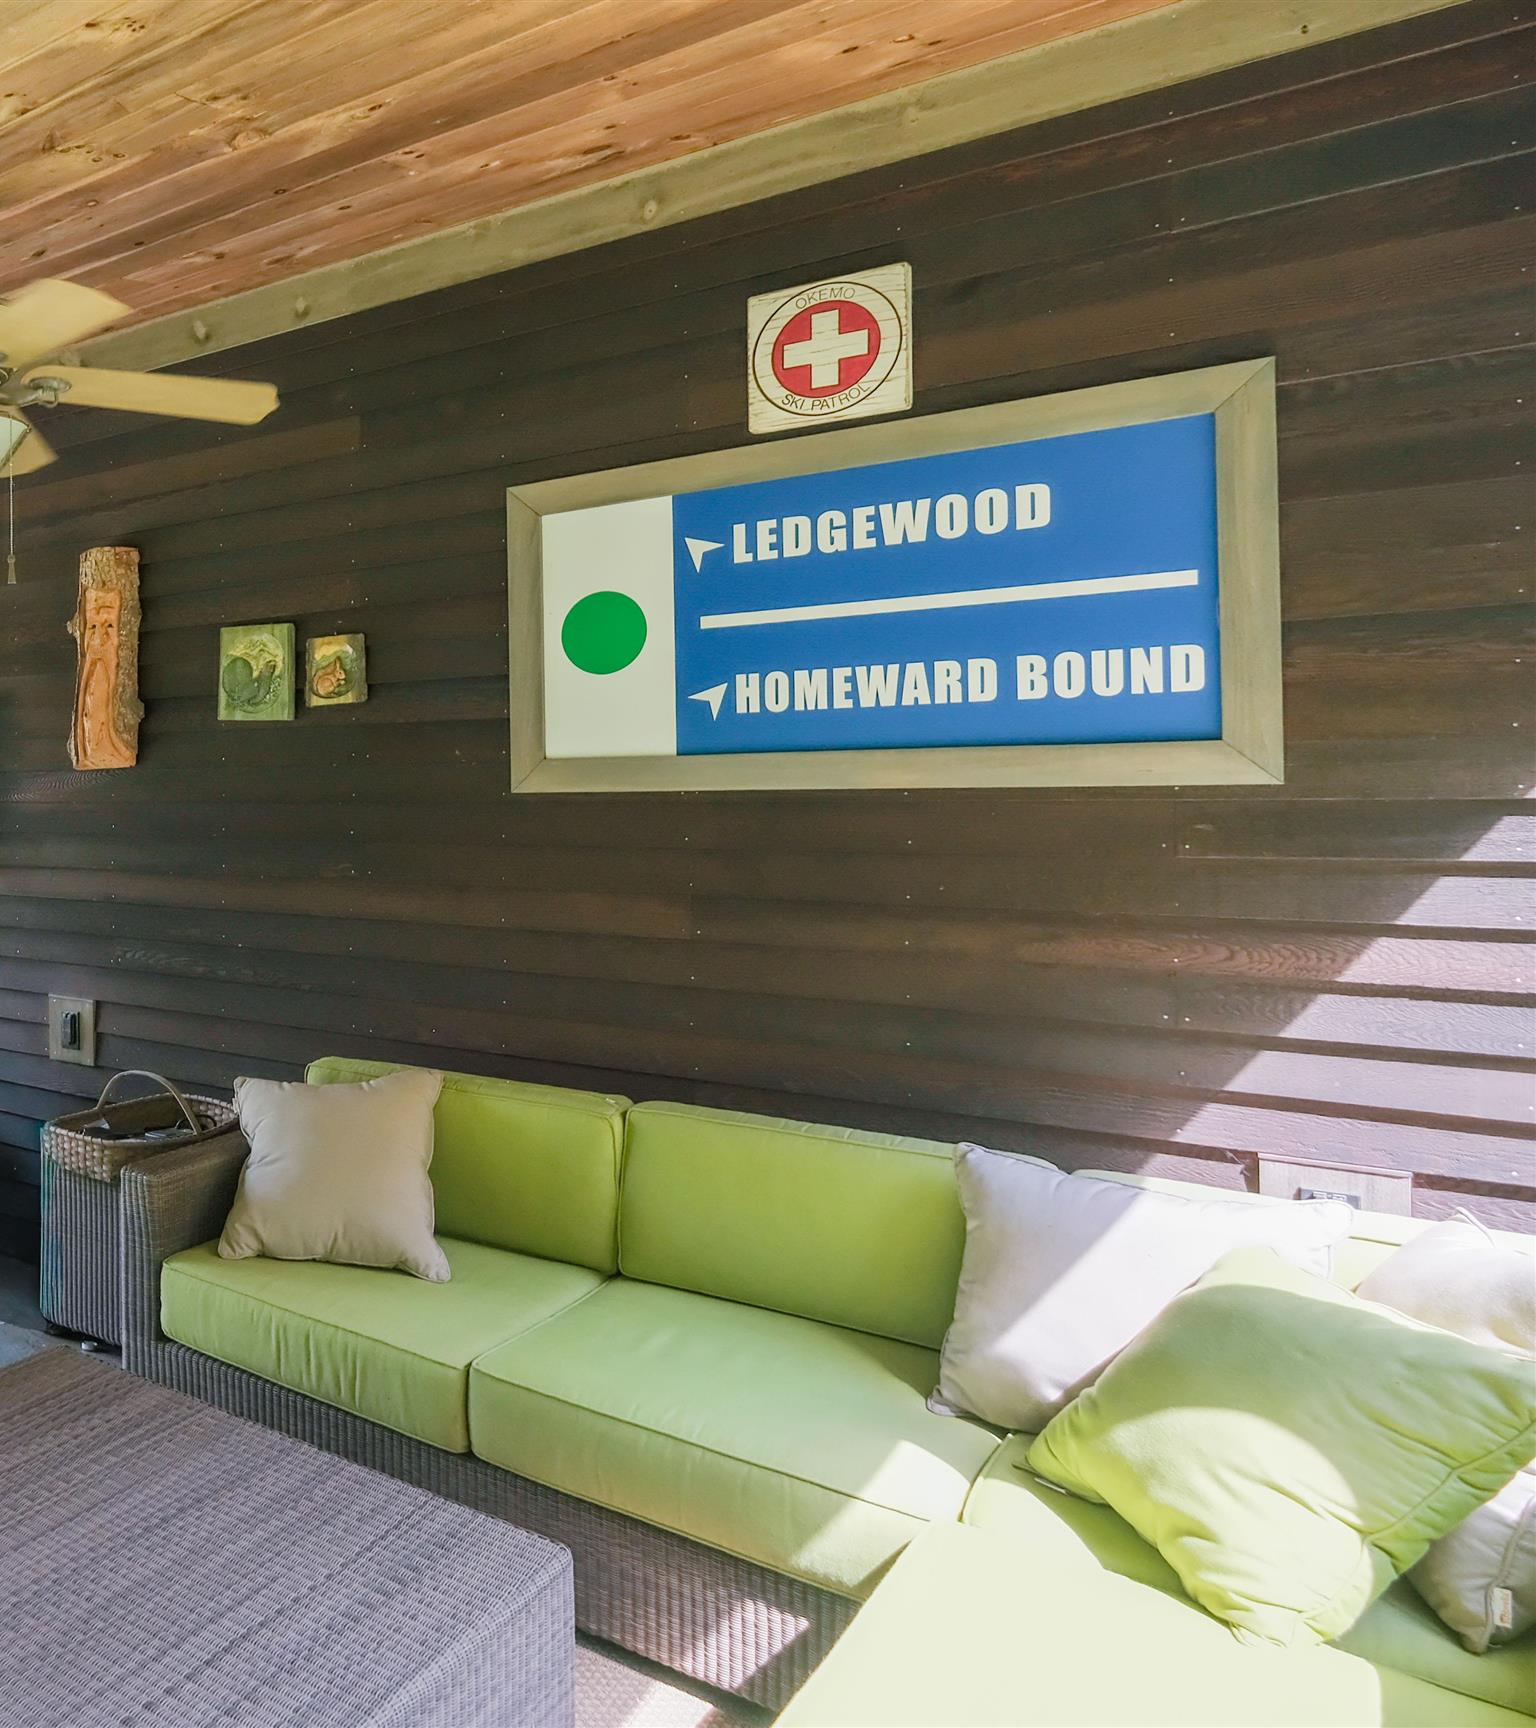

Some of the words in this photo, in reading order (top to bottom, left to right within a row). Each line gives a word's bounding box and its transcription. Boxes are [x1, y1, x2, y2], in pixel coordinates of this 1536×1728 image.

[795, 287, 855, 310] OKEMO
[781, 393, 805, 410] SKI
[811, 384, 870, 411] PATROL
[732, 483, 1051, 563] LEDGEWOOD
[735, 659, 997, 714] HOMEWARD
[1016, 644, 1206, 700] BOUND
